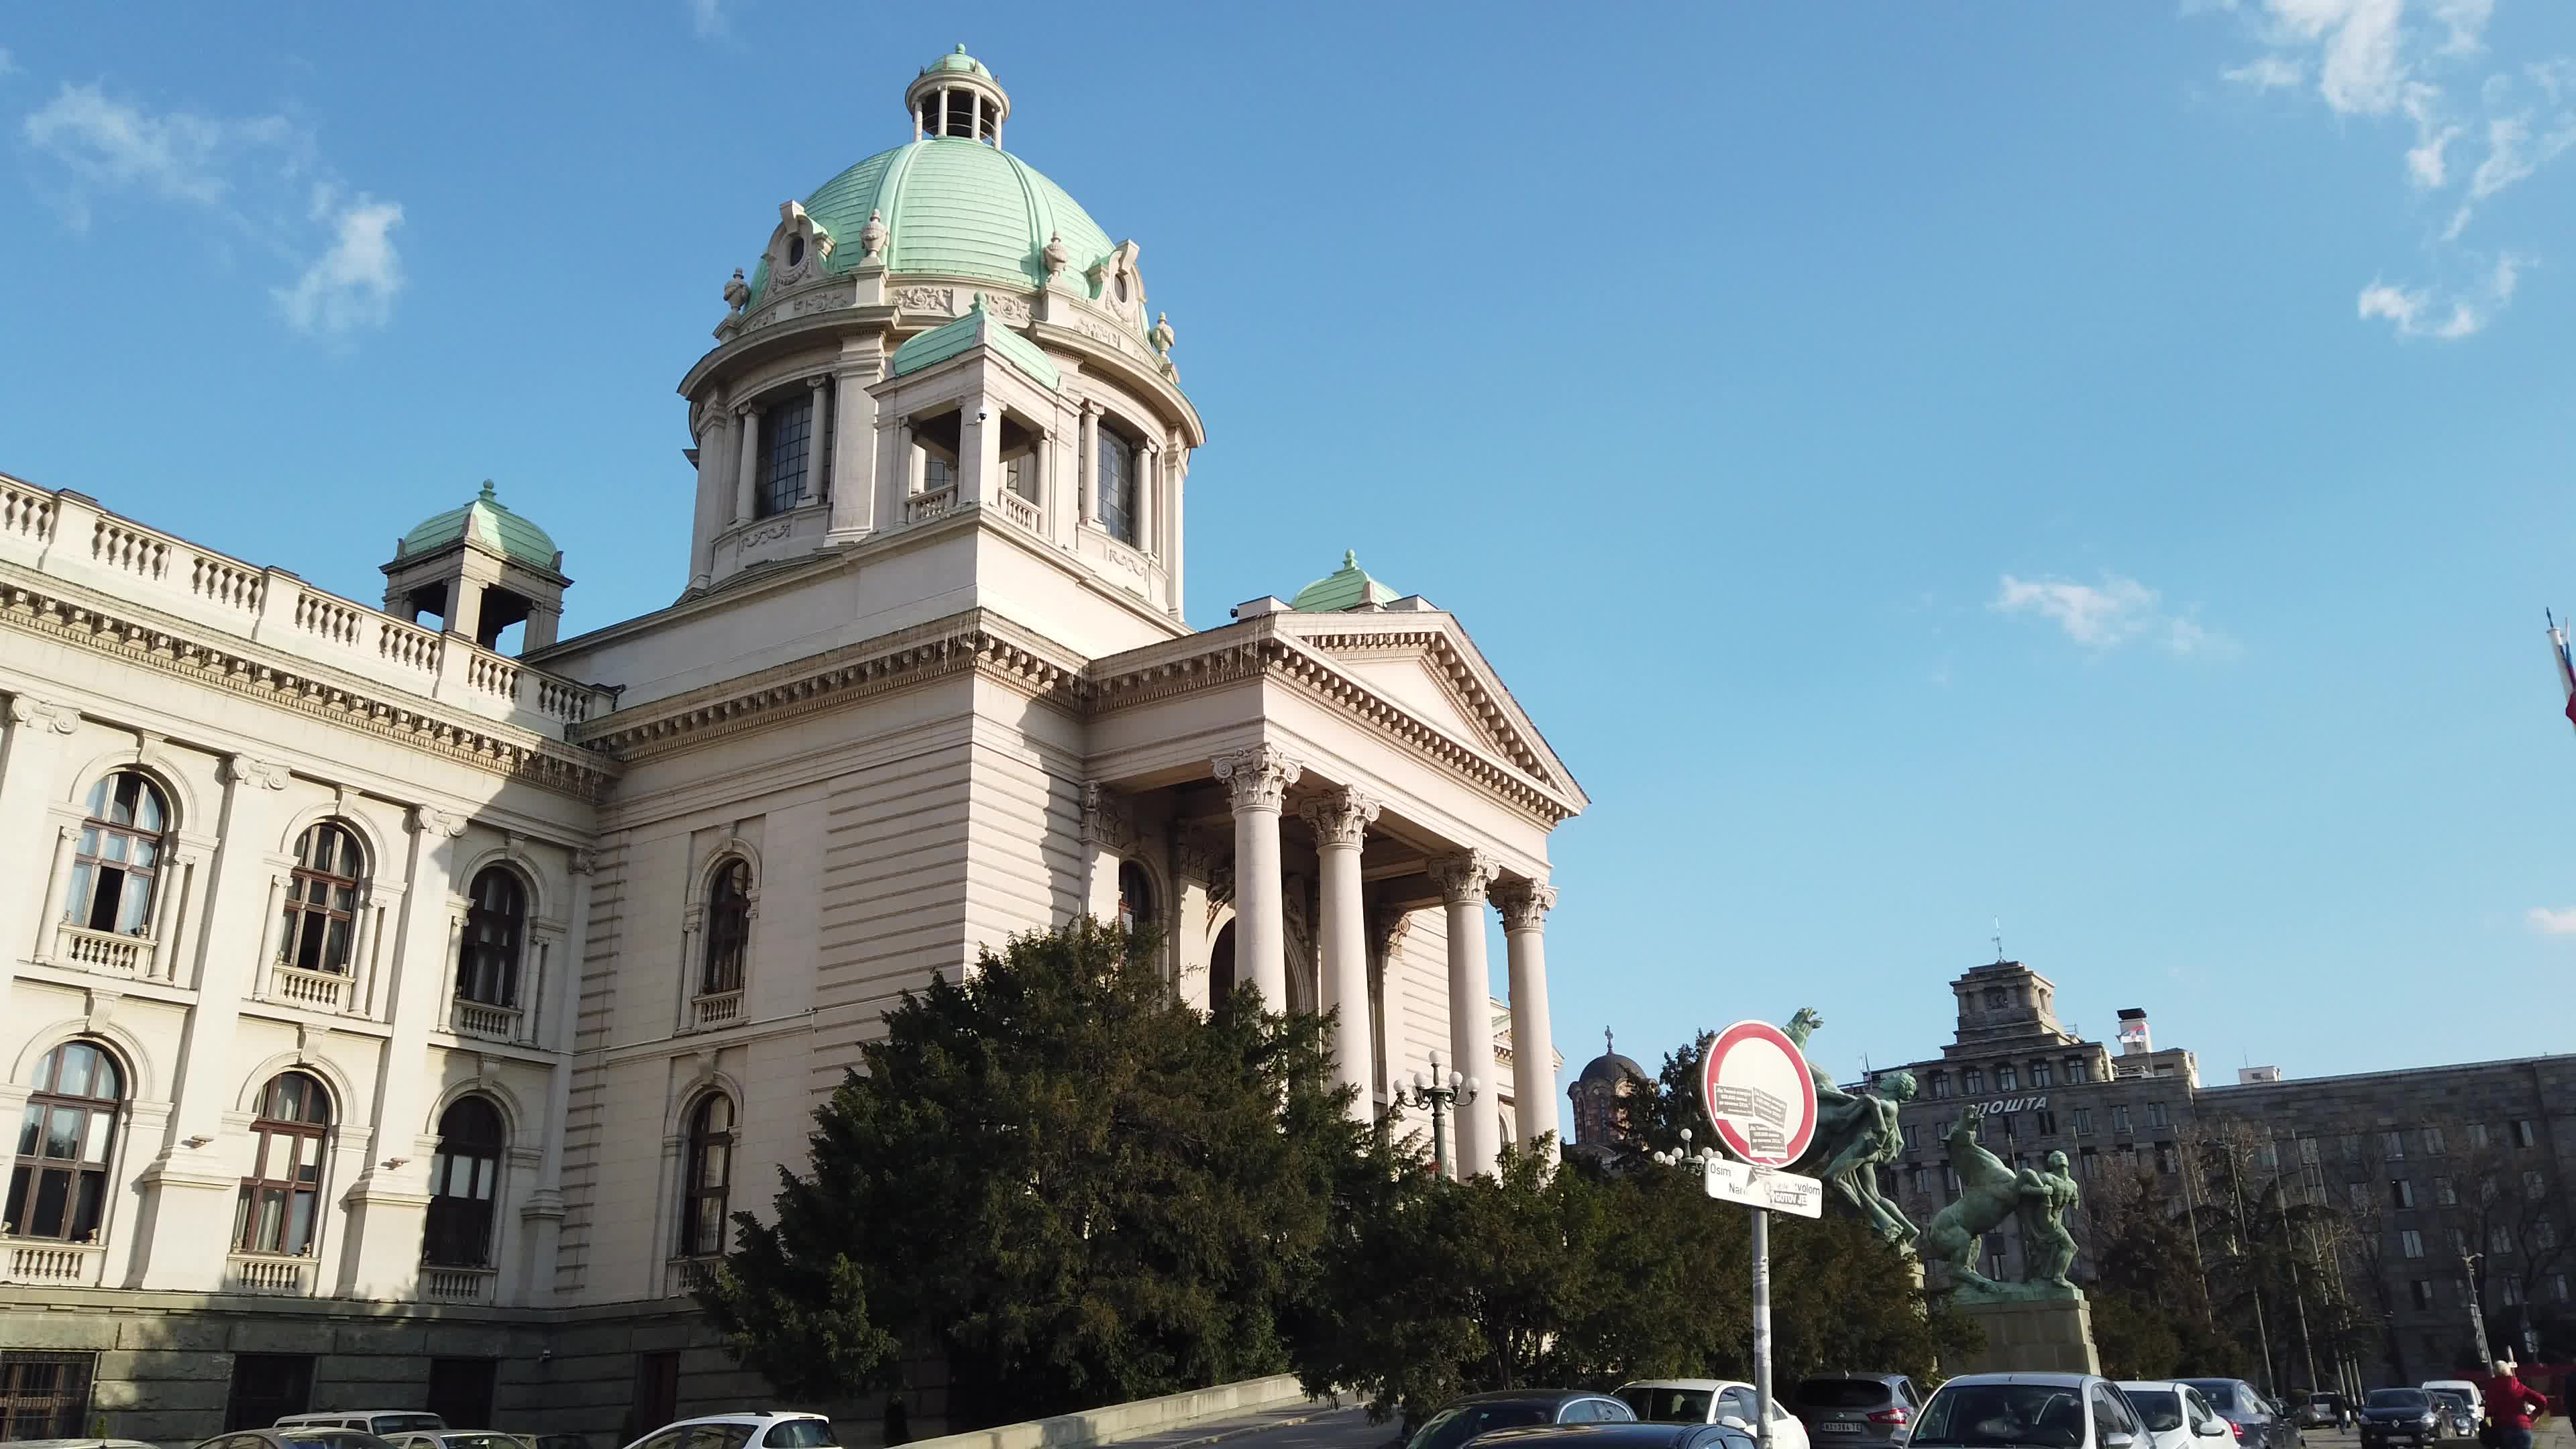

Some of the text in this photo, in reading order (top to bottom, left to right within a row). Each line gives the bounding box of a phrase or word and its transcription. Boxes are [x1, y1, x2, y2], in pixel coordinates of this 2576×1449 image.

[1975, 1097, 2047, 1116] ПОШТА
[1710, 1163, 1731, 1177] Osim
[1794, 1183, 1821, 1196] volom
[1776, 1192, 1796, 1203] GOTOV
